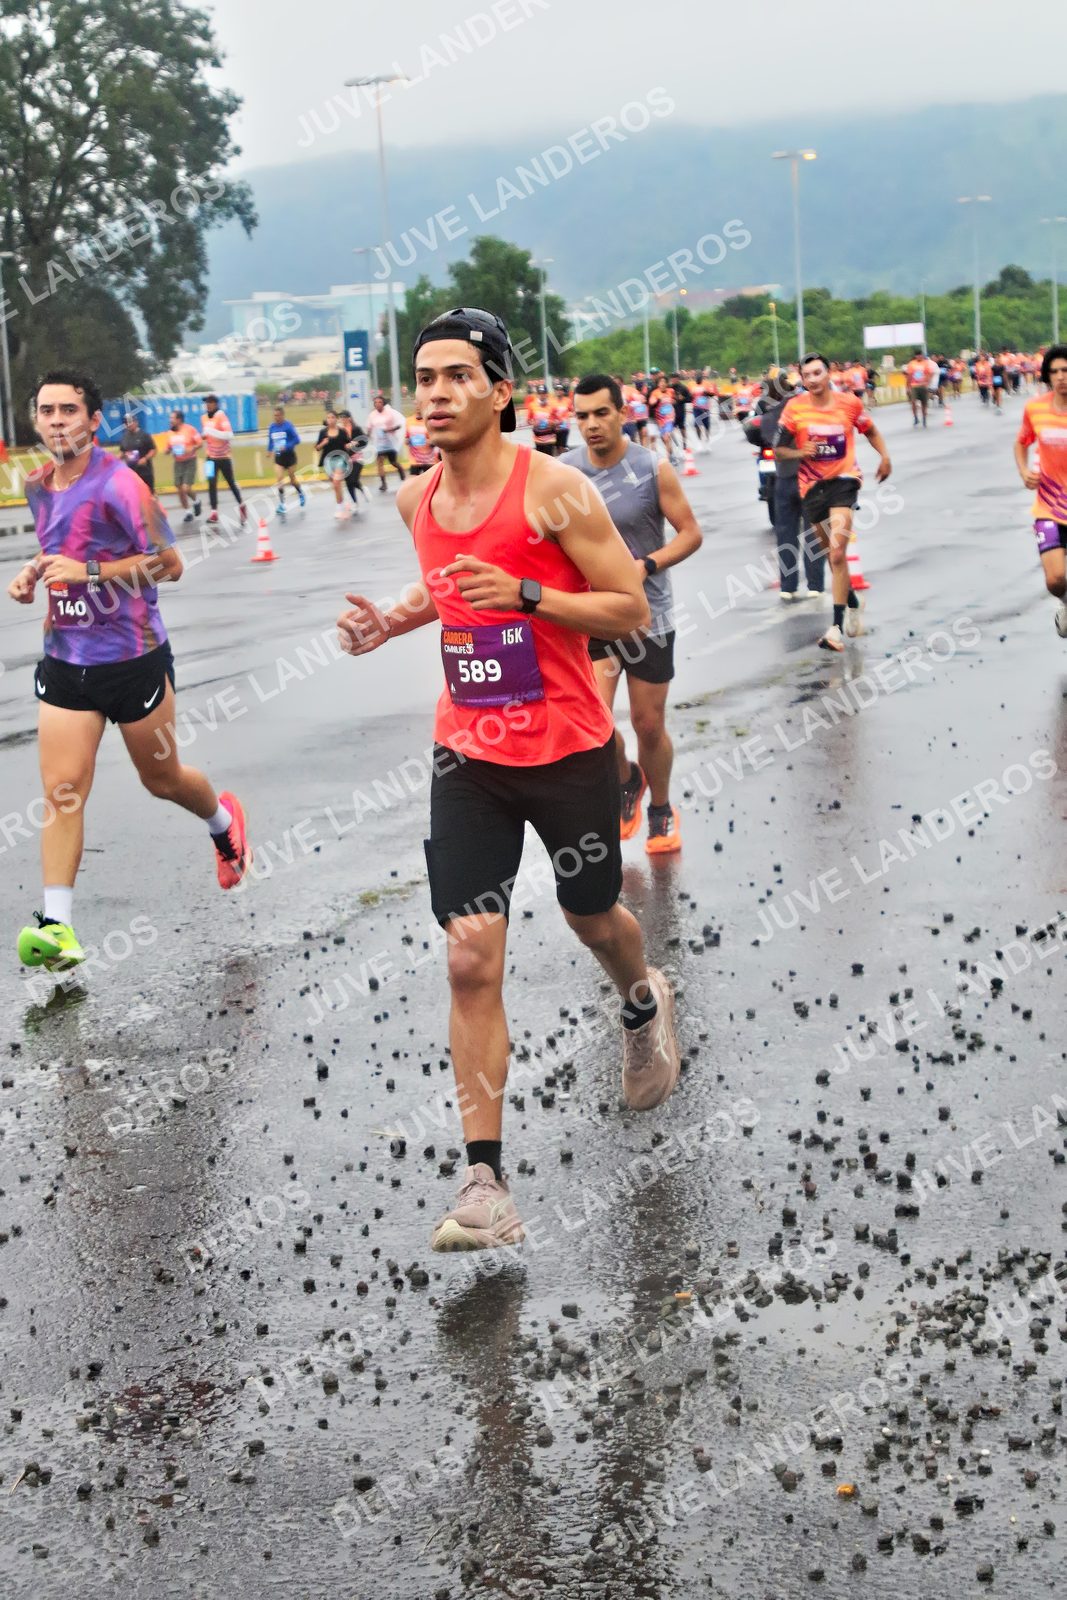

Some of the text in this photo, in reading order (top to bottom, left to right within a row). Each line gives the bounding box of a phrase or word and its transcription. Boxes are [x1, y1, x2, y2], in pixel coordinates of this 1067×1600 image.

[347, 347, 364, 367] E
[57, 600, 87, 616] 140
[501, 627, 523, 645] 15K
[458, 659, 502, 683] 589
